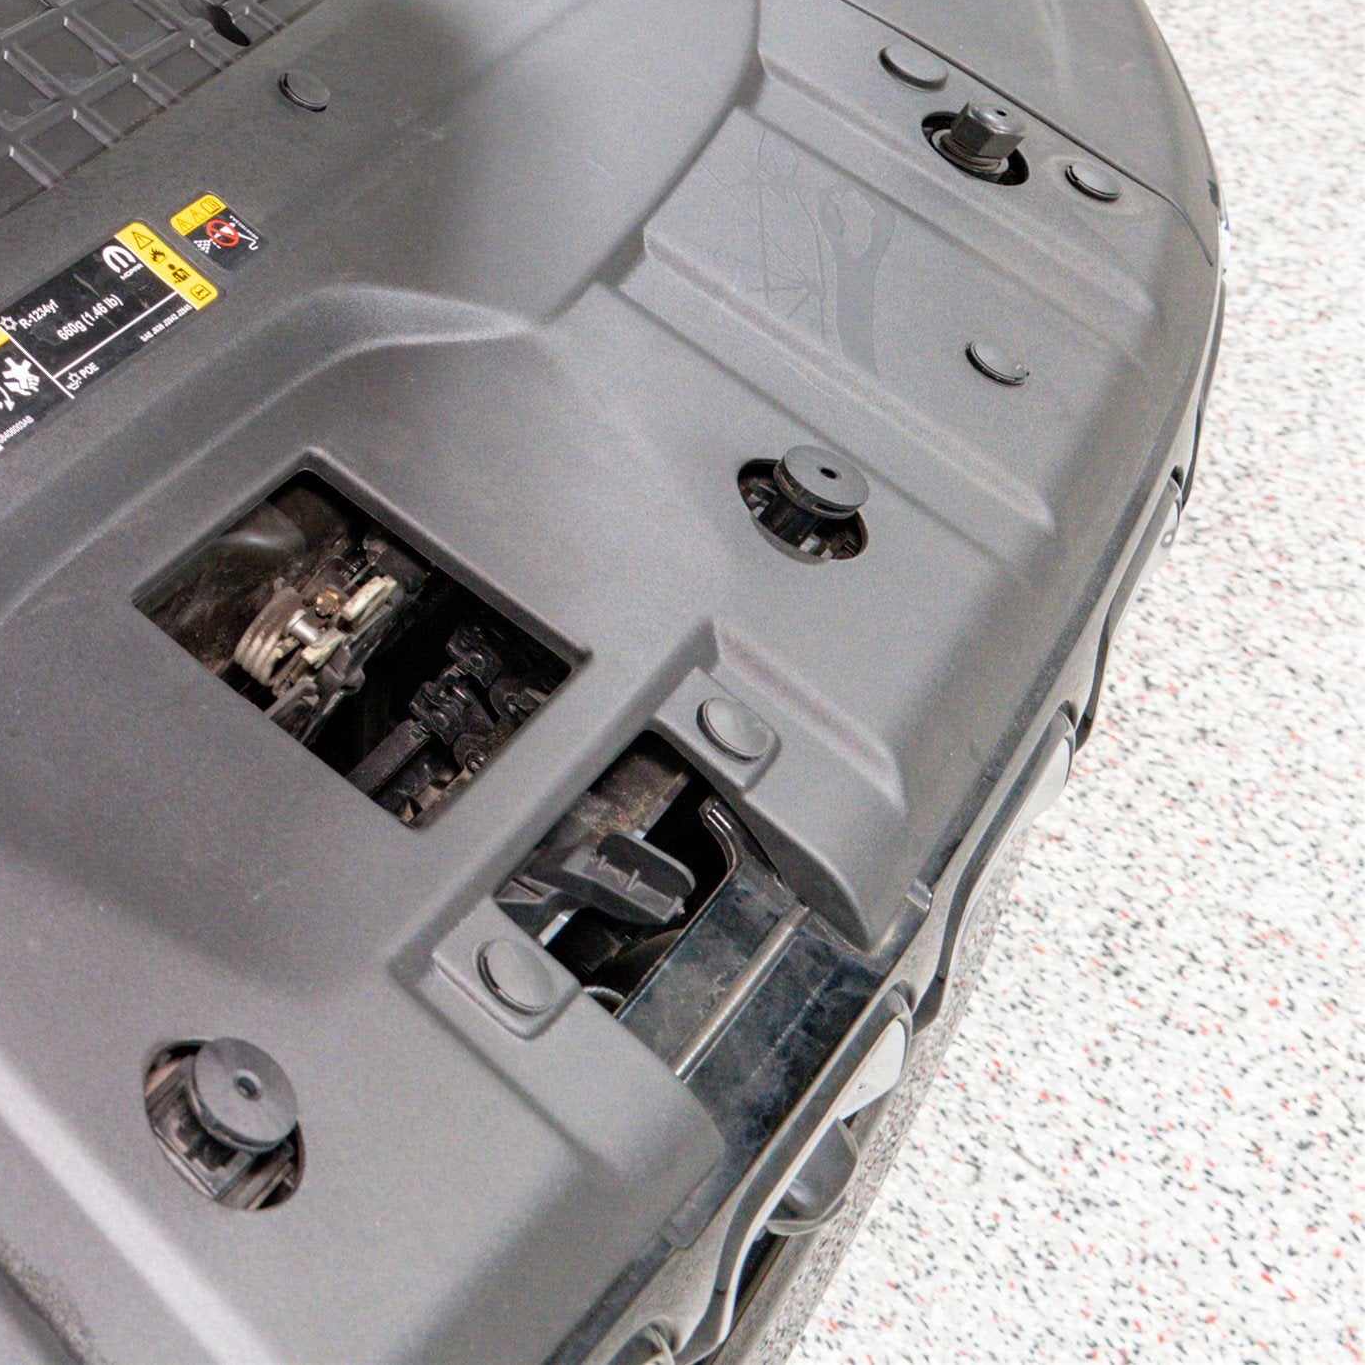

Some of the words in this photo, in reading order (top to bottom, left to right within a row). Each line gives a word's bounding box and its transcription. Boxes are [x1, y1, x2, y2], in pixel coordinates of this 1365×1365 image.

[18, 298, 59, 330] R-1234yf
[57, 321, 87, 342] 660g
[83, 302, 107, 327] (1.46
[104, 293, 124, 311] lb)
[79, 362, 100, 379] POE
